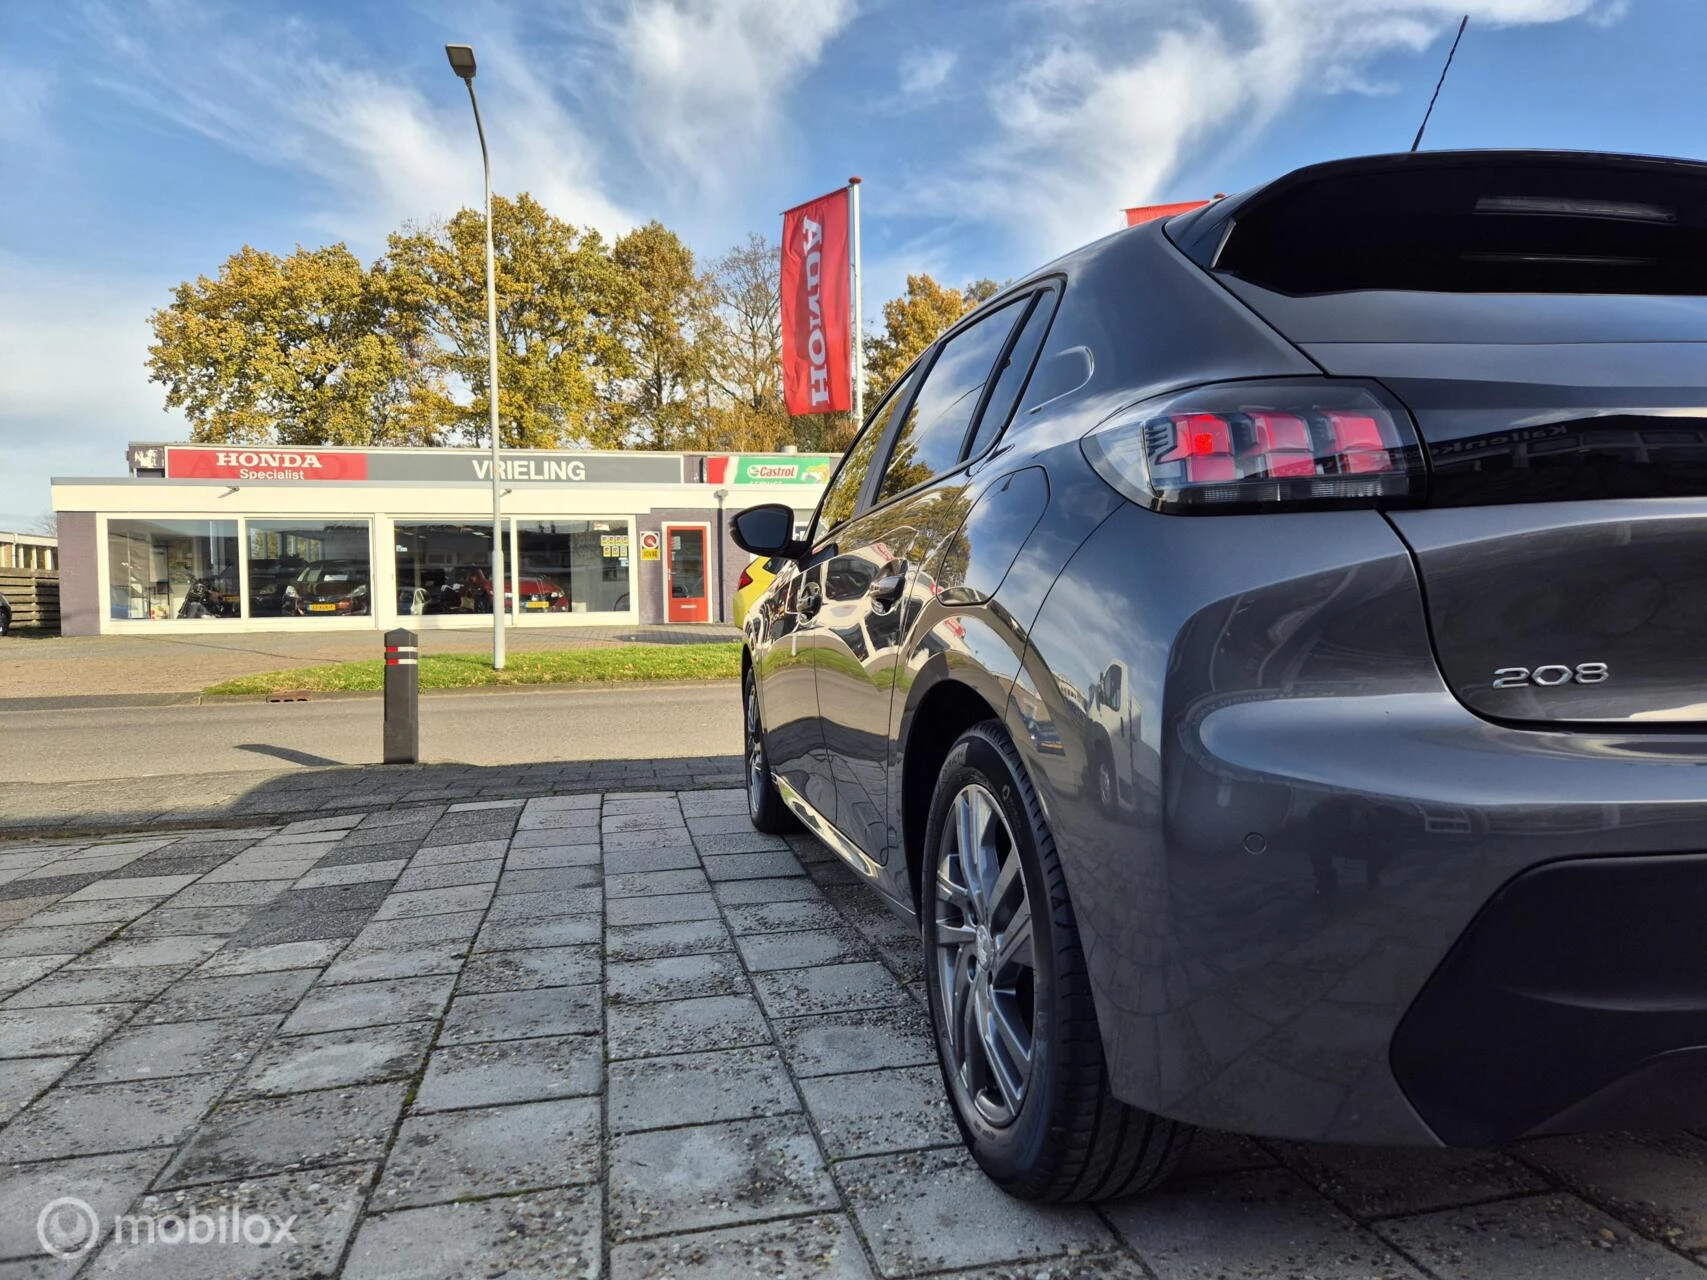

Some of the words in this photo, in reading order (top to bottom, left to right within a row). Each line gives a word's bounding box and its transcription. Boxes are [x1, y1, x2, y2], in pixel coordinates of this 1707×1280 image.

[803, 215, 830, 407] HONDA
[216, 453, 323, 468] HONDA
[239, 468, 305, 480] Specialist
[472, 459, 586, 481] VRIELING
[759, 466, 796, 478] Castrol
[1492, 662, 1609, 689] 208
